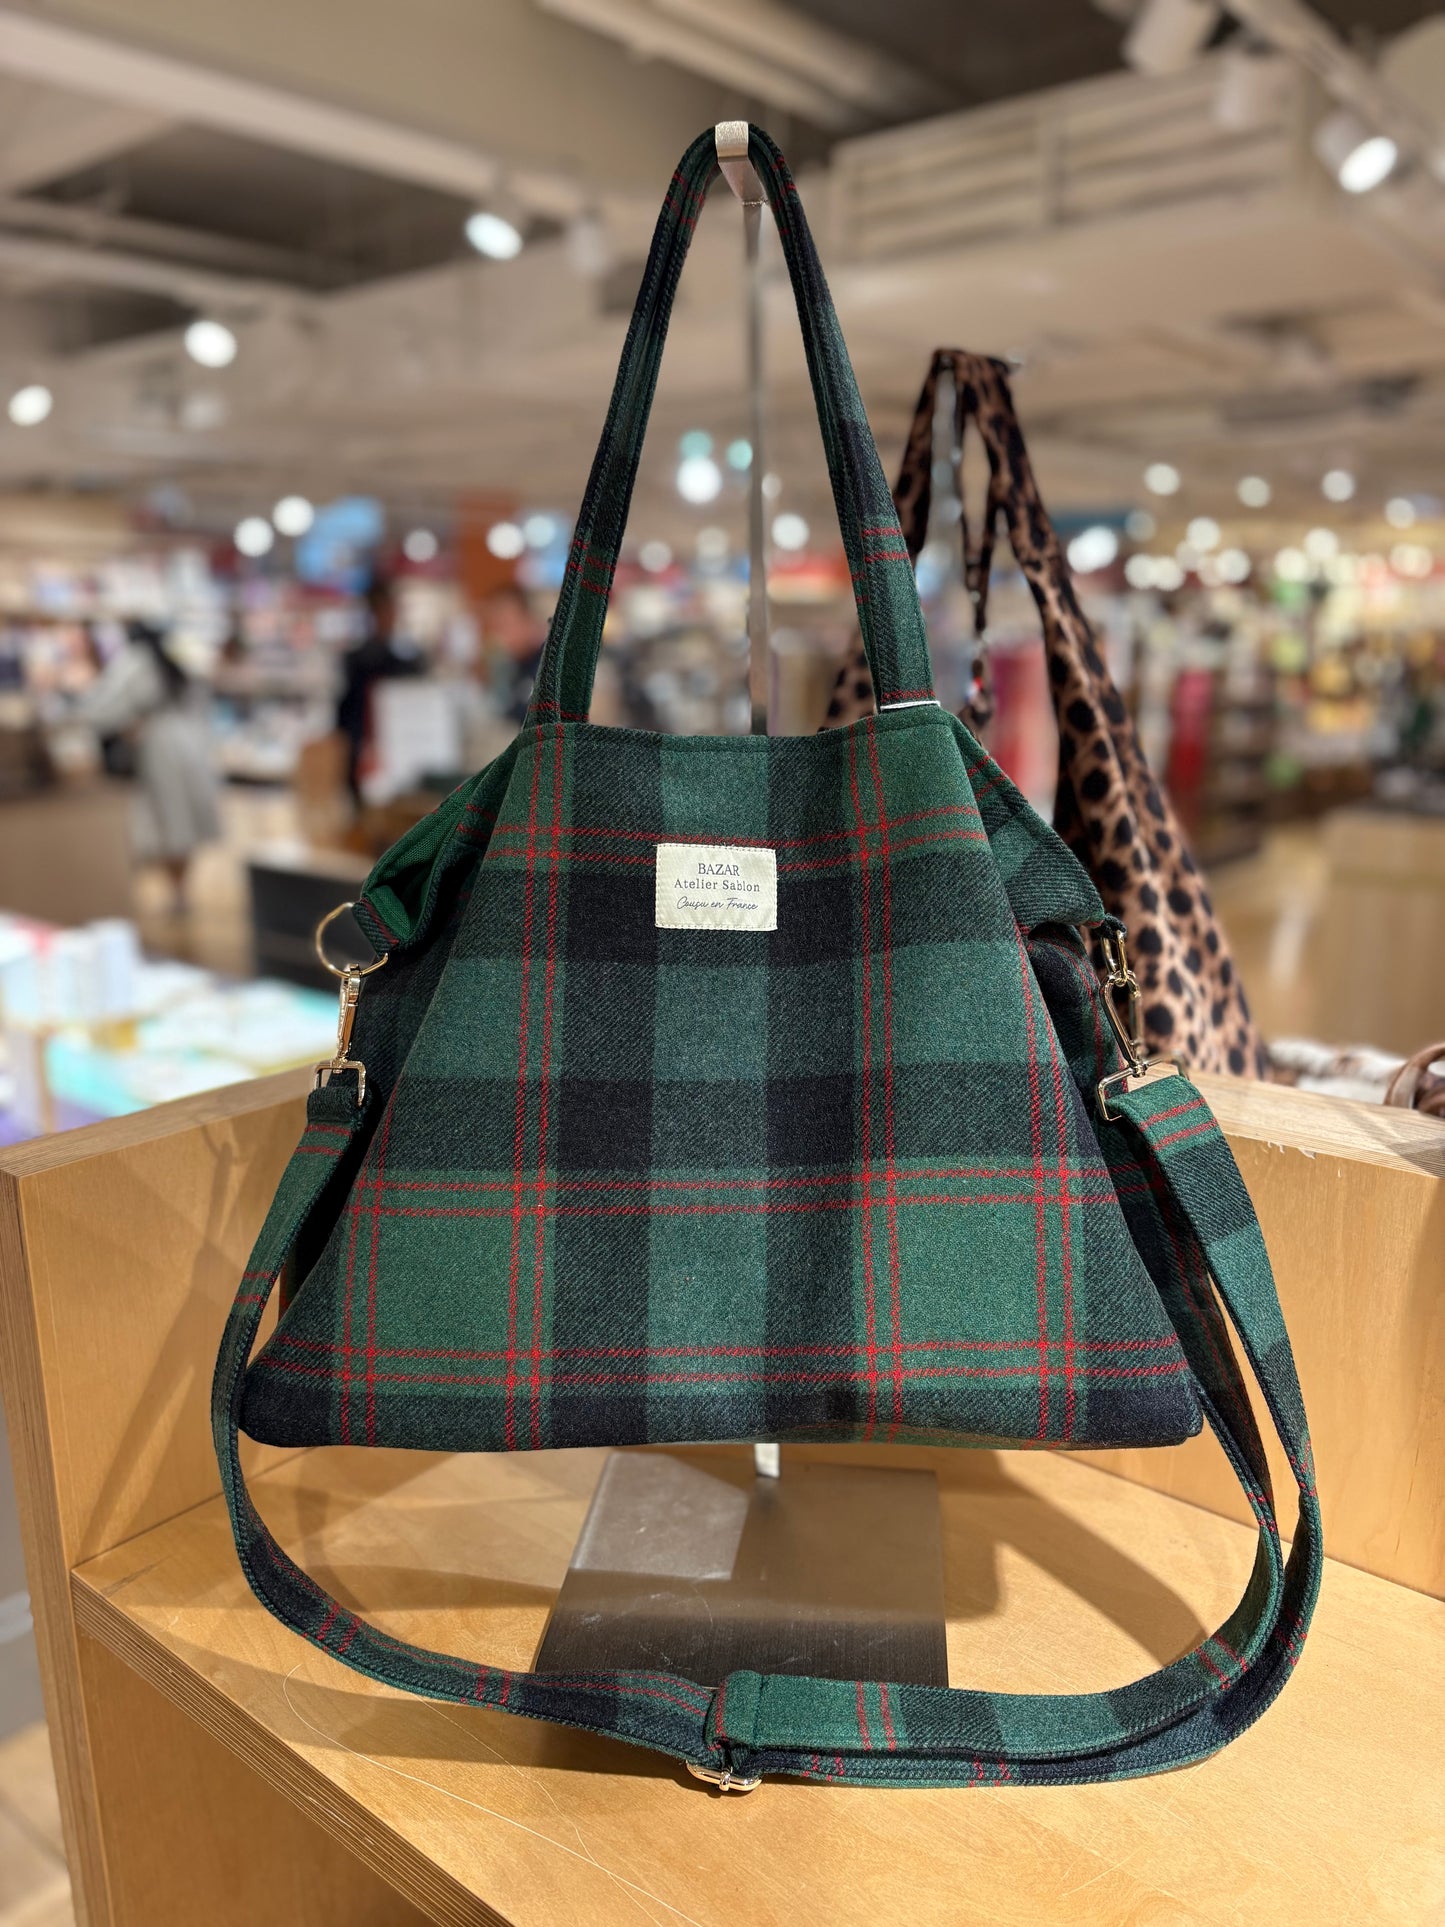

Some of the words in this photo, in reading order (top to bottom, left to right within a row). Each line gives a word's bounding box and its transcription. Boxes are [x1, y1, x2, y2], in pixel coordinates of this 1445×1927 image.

[698, 863, 740, 876] BAZAR
[674, 878, 718, 890] Atelier
[722, 880, 760, 892] Sablon
[676, 896, 709, 910] Cousu
[726, 897, 759, 910] France
